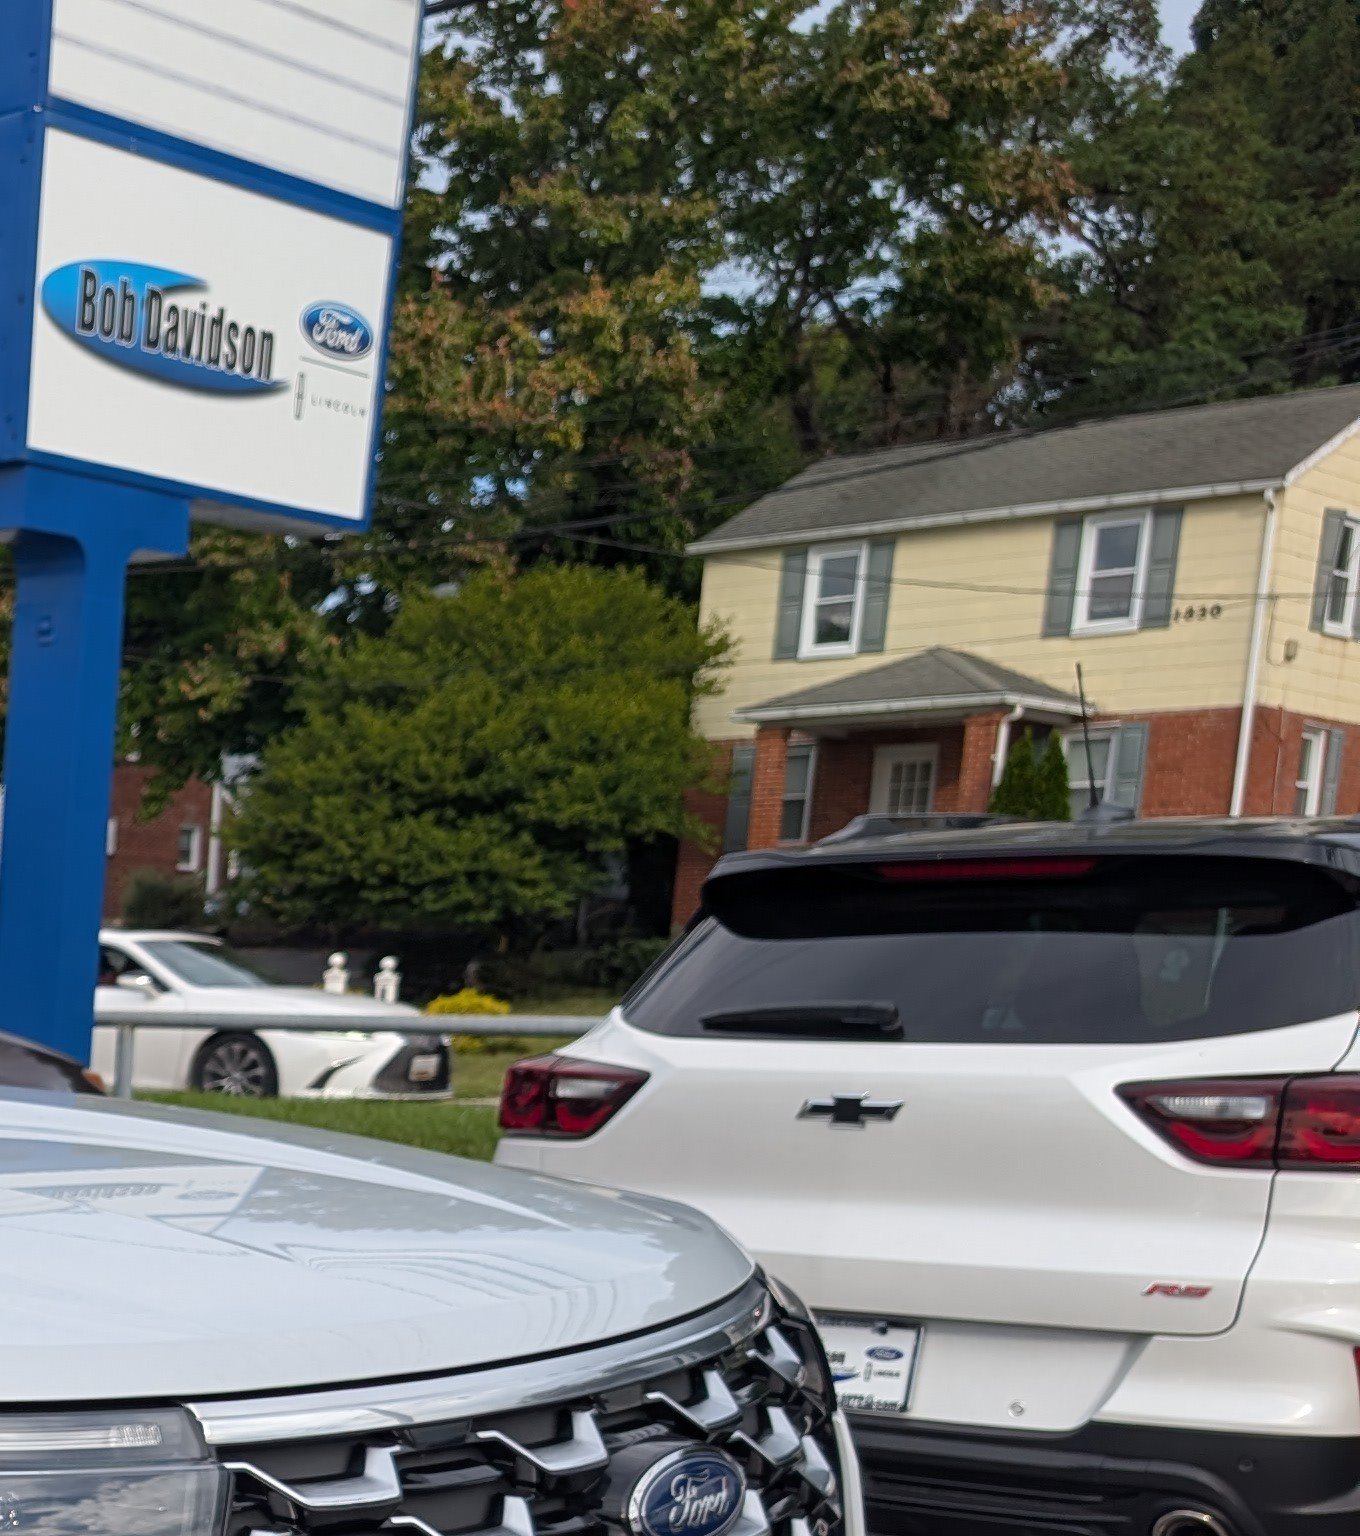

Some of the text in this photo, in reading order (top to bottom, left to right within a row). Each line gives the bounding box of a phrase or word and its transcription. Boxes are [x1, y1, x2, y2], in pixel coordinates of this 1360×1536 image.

[77, 265, 275, 383] Bob Davidson
[311, 308, 366, 354] Ford
[310, 393, 368, 418] LINCOLN
[1143, 1281, 1212, 1299] RS
[667, 1466, 730, 1534] Ford
